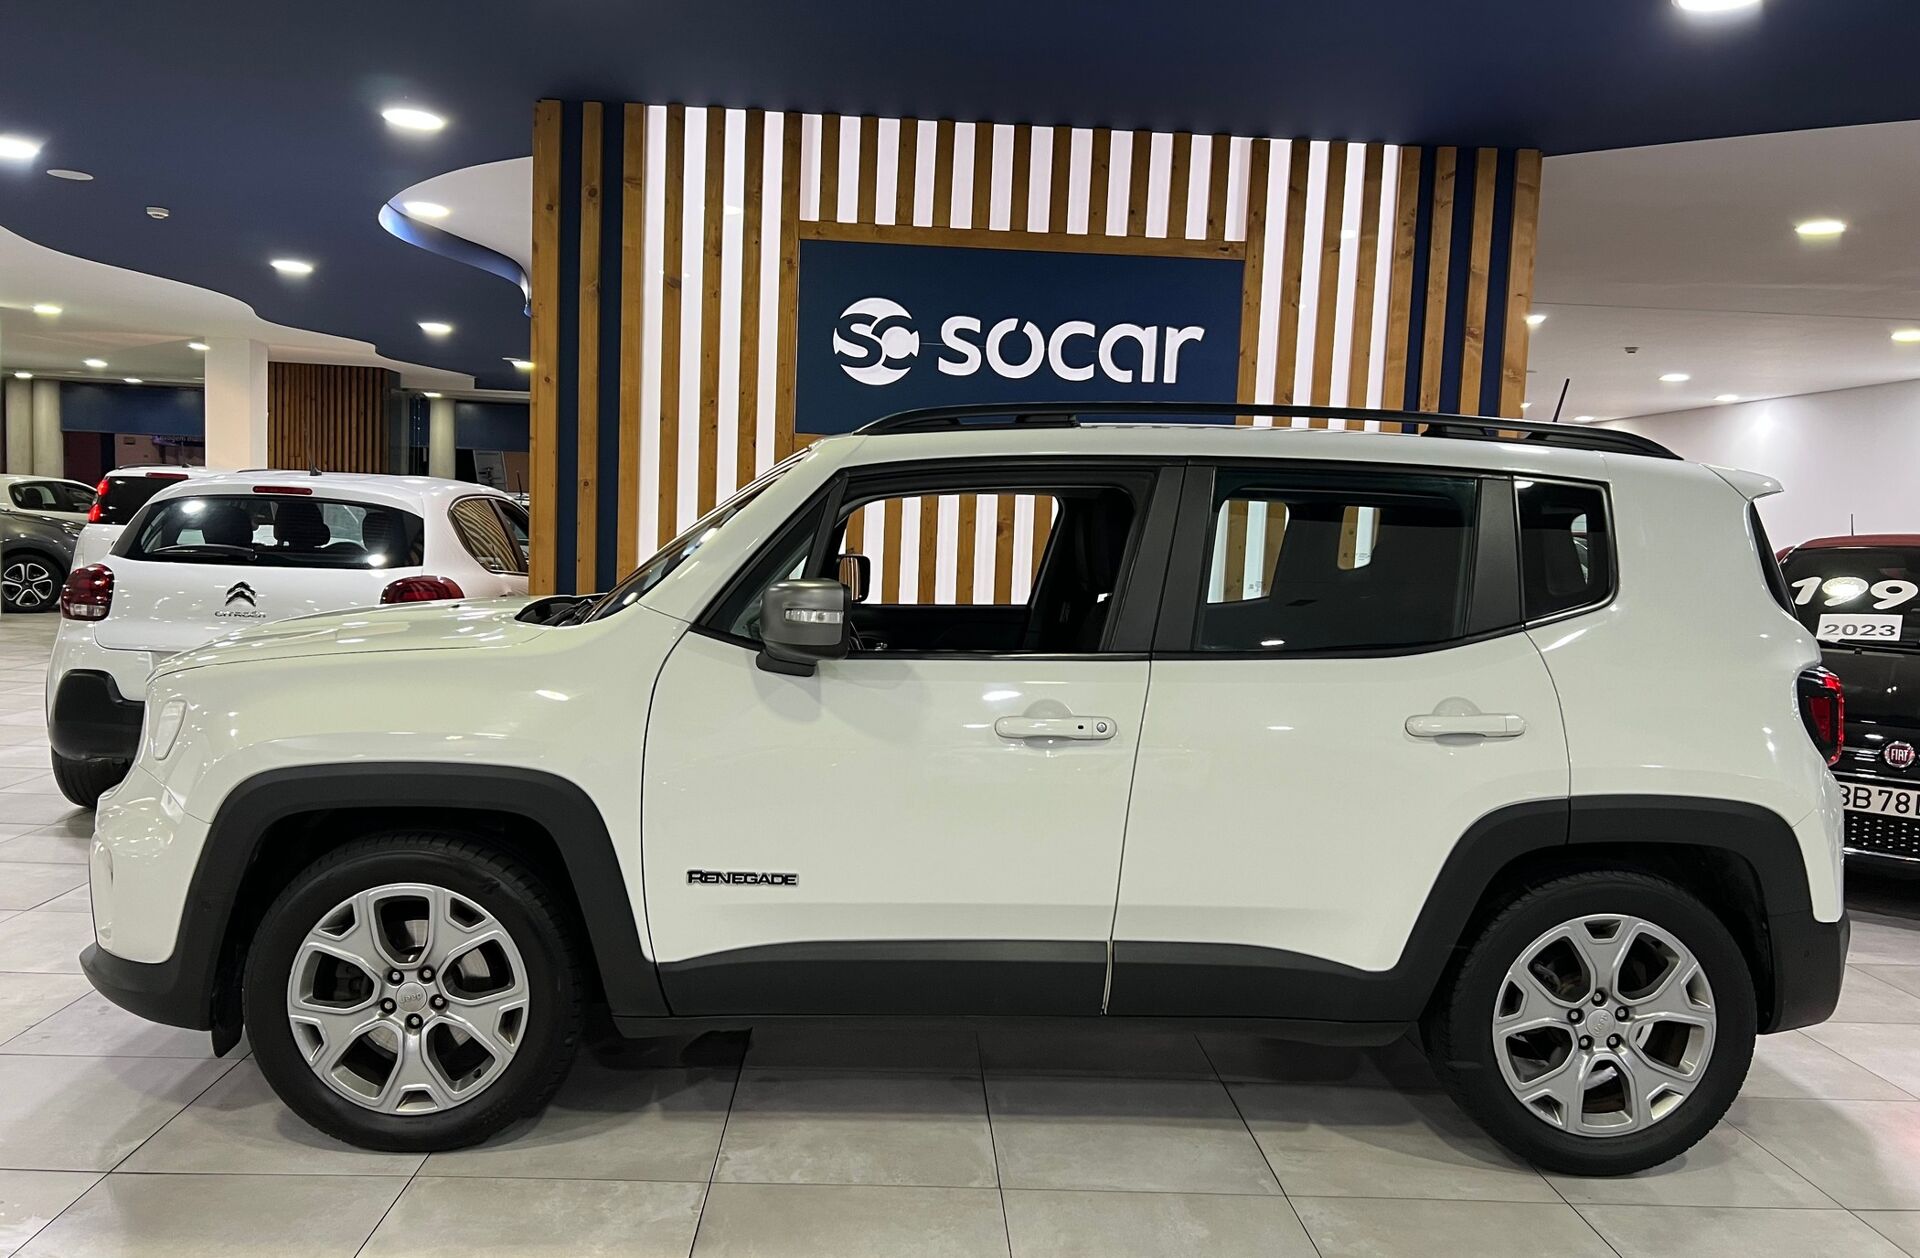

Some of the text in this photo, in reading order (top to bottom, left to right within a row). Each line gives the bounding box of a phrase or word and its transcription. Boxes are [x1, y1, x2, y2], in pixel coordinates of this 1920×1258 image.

[1791, 576, 1919, 610] 199
[1822, 623, 1897, 637] 2023
[1890, 748, 1909, 761] FIAT
[1878, 789, 1911, 814] 78
[686, 869, 798, 886] RENEGADE
